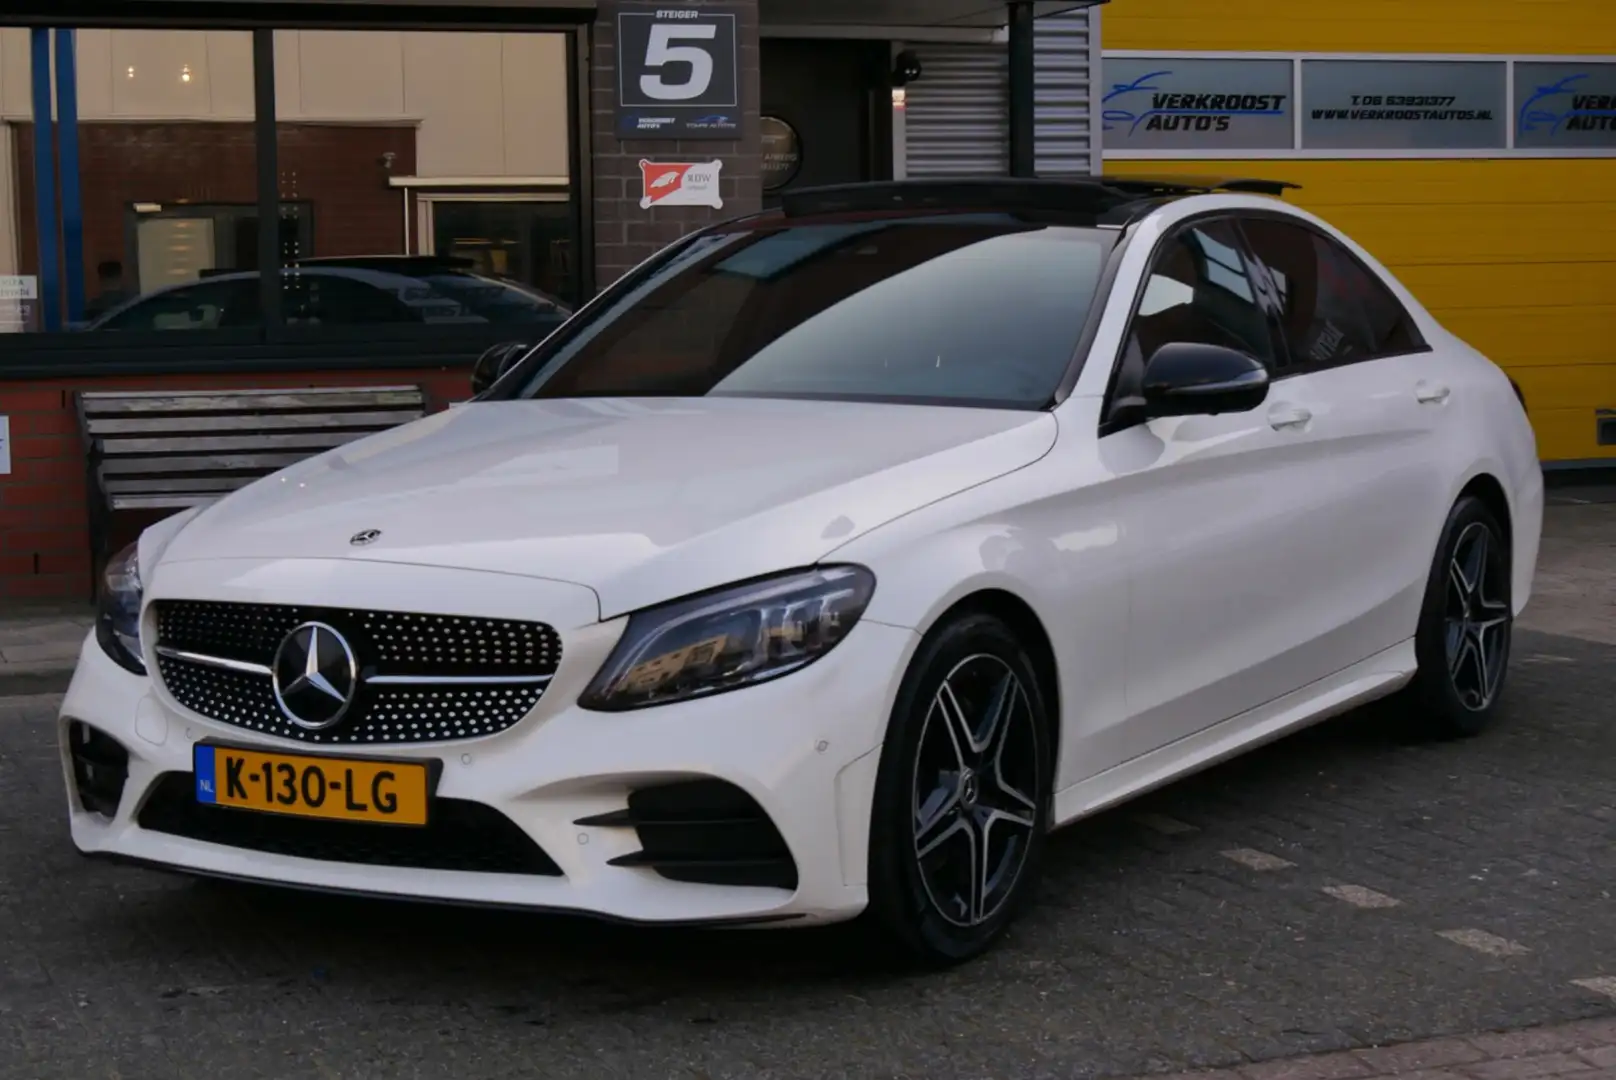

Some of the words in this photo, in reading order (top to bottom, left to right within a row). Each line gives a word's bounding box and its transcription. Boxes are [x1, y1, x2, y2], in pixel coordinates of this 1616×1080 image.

[655, 10, 699, 19] STEIGER
[639, 23, 717, 100] 5
[1152, 93, 1287, 111] VERKROOST
[1145, 114, 1230, 131] AUTO'S
[200, 779, 214, 793] NL
[226, 756, 398, 814] K-130-LG
